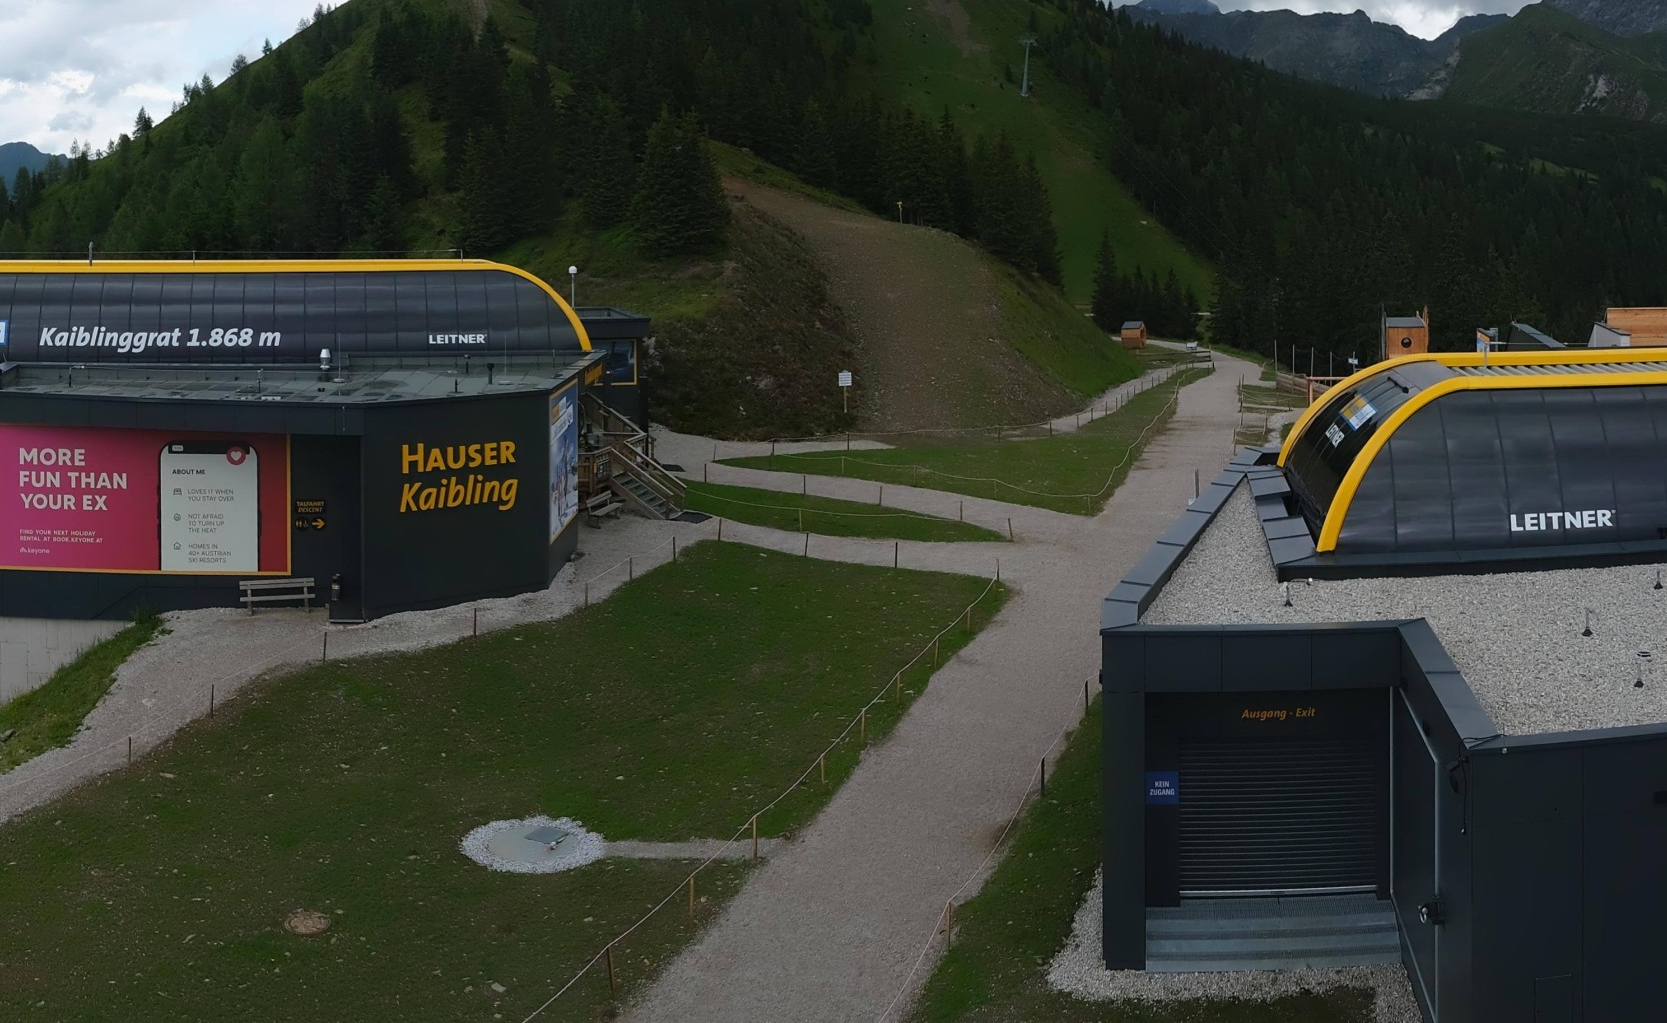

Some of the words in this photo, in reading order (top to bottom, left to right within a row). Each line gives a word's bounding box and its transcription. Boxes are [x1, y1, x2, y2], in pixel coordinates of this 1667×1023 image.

[39, 326, 181, 353] Kaiblinggrat
[186, 328, 252, 347] 1.868
[258, 331, 281, 347] m
[428, 334, 486, 344] LEITNER
[20, 447, 86, 466] MORE
[402, 441, 516, 474] HAUSER
[20, 471, 60, 488] FUN
[67, 472, 128, 489] THAN
[20, 493, 76, 510] YOUR
[82, 495, 108, 511] EX
[400, 475, 518, 513] Kaibling
[1510, 509, 1614, 531] LEITNER
[1242, 708, 1287, 721] Ausgang
[1296, 707, 1316, 717] Exit
[1150, 788, 1175, 796] ZUGANG
